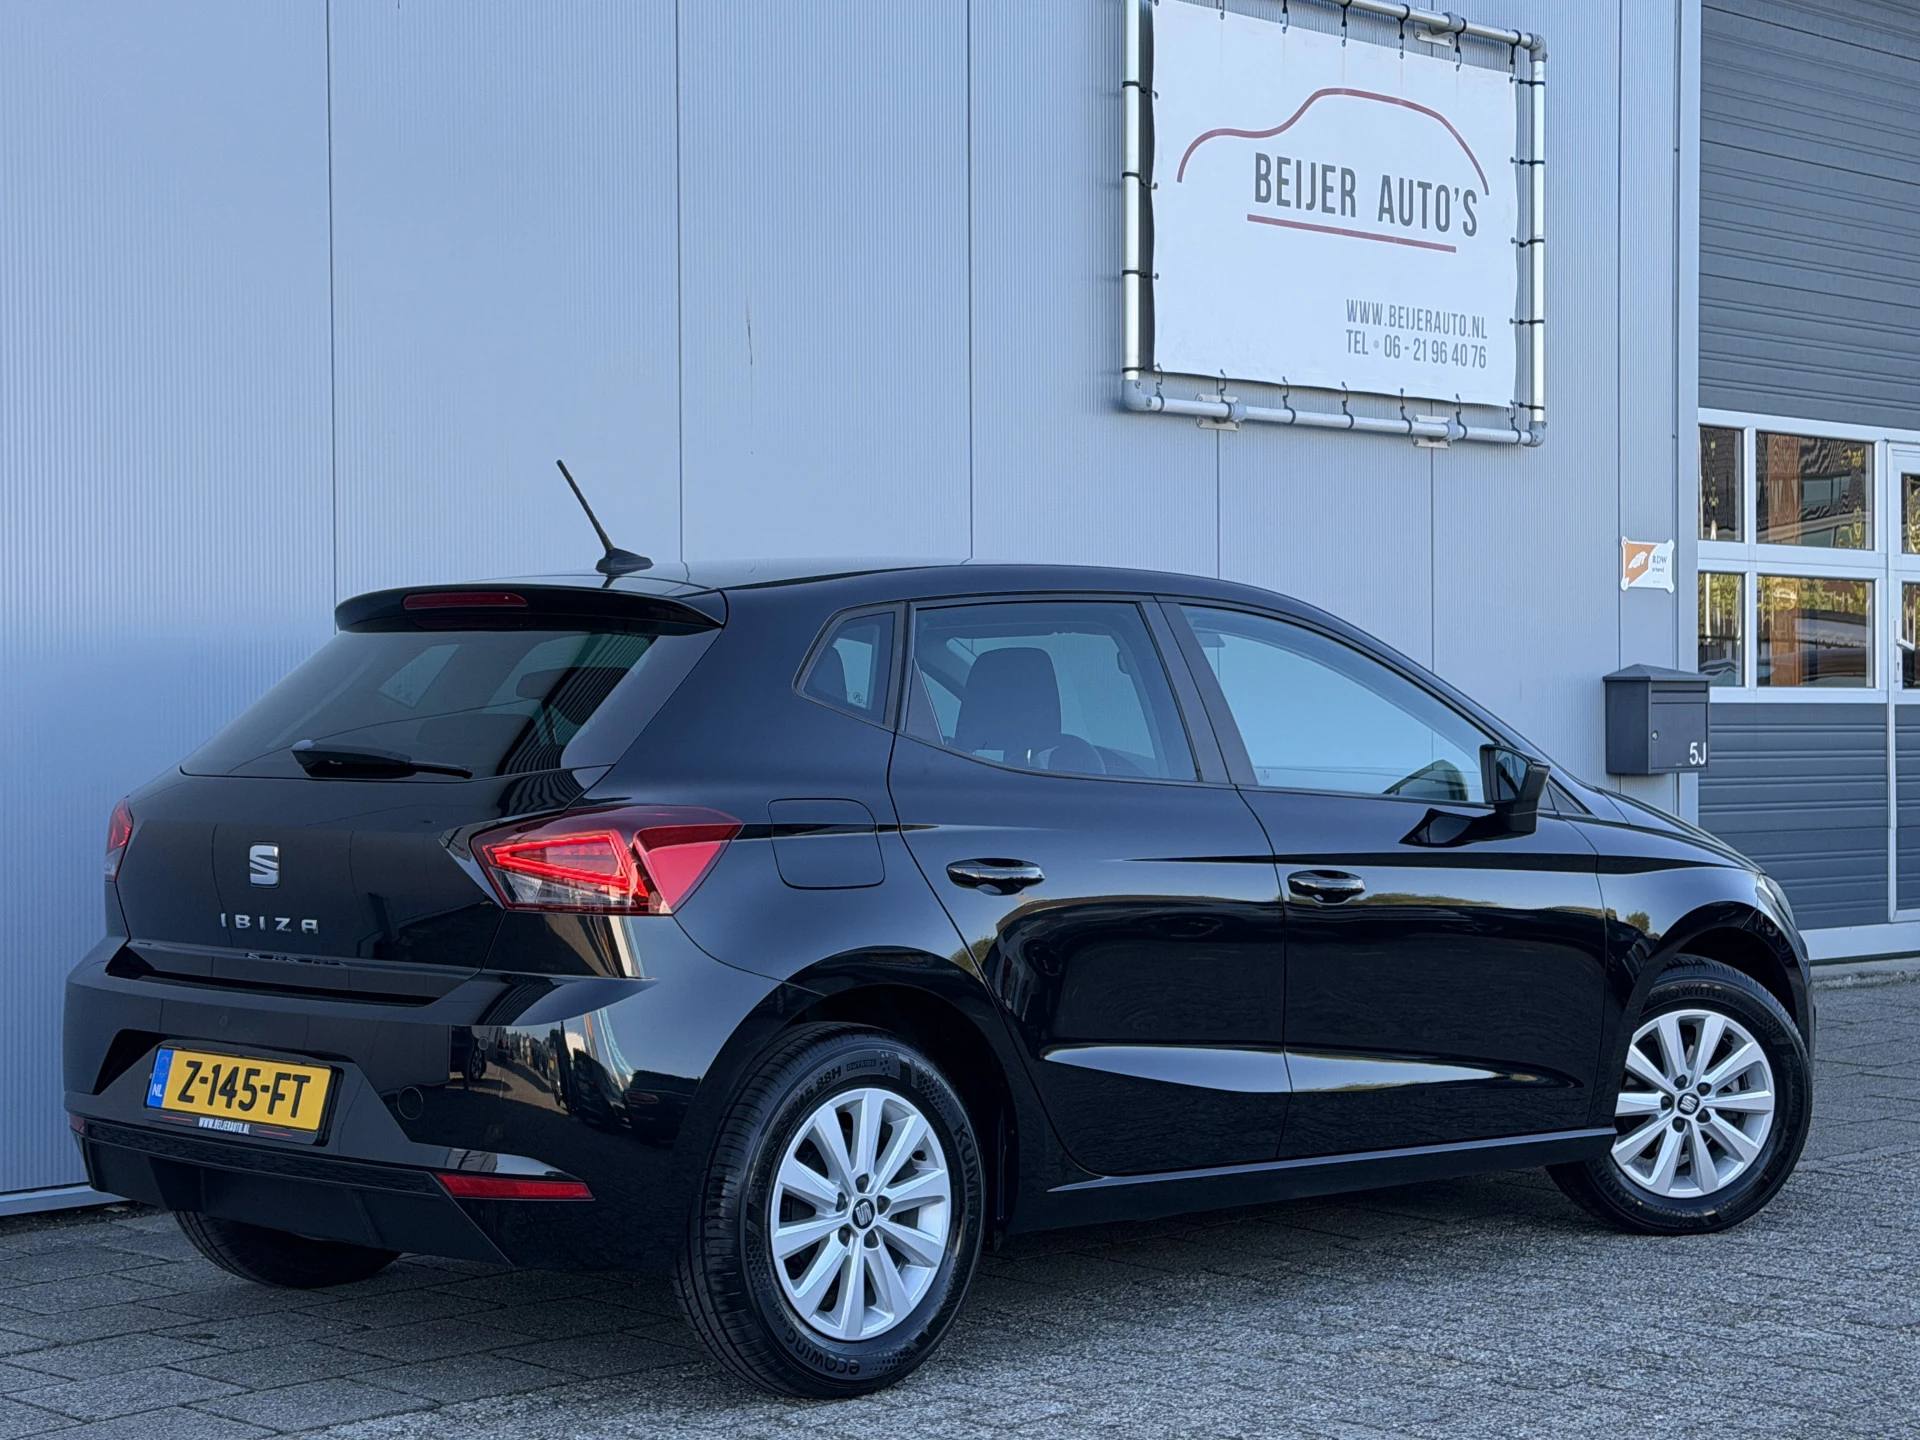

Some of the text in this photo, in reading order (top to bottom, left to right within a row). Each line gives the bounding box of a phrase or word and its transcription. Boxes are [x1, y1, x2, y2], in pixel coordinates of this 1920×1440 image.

[1255, 152, 1477, 237] BEIJER AUTO'S
[1346, 299, 1488, 339] WWW.BEIJERAUTO.NL
[1346, 329, 1369, 355] TEL
[1384, 334, 1401, 359] 06
[1413, 338, 1427, 362] 21
[1431, 340, 1448, 364] 96
[1451, 342, 1468, 367] 40
[1471, 345, 1487, 369] 76
[1689, 742, 1707, 765] 5J
[220, 912, 319, 934] IBIZA
[151, 1083, 163, 1098] NL
[177, 1060, 311, 1118] Z-145-FT
